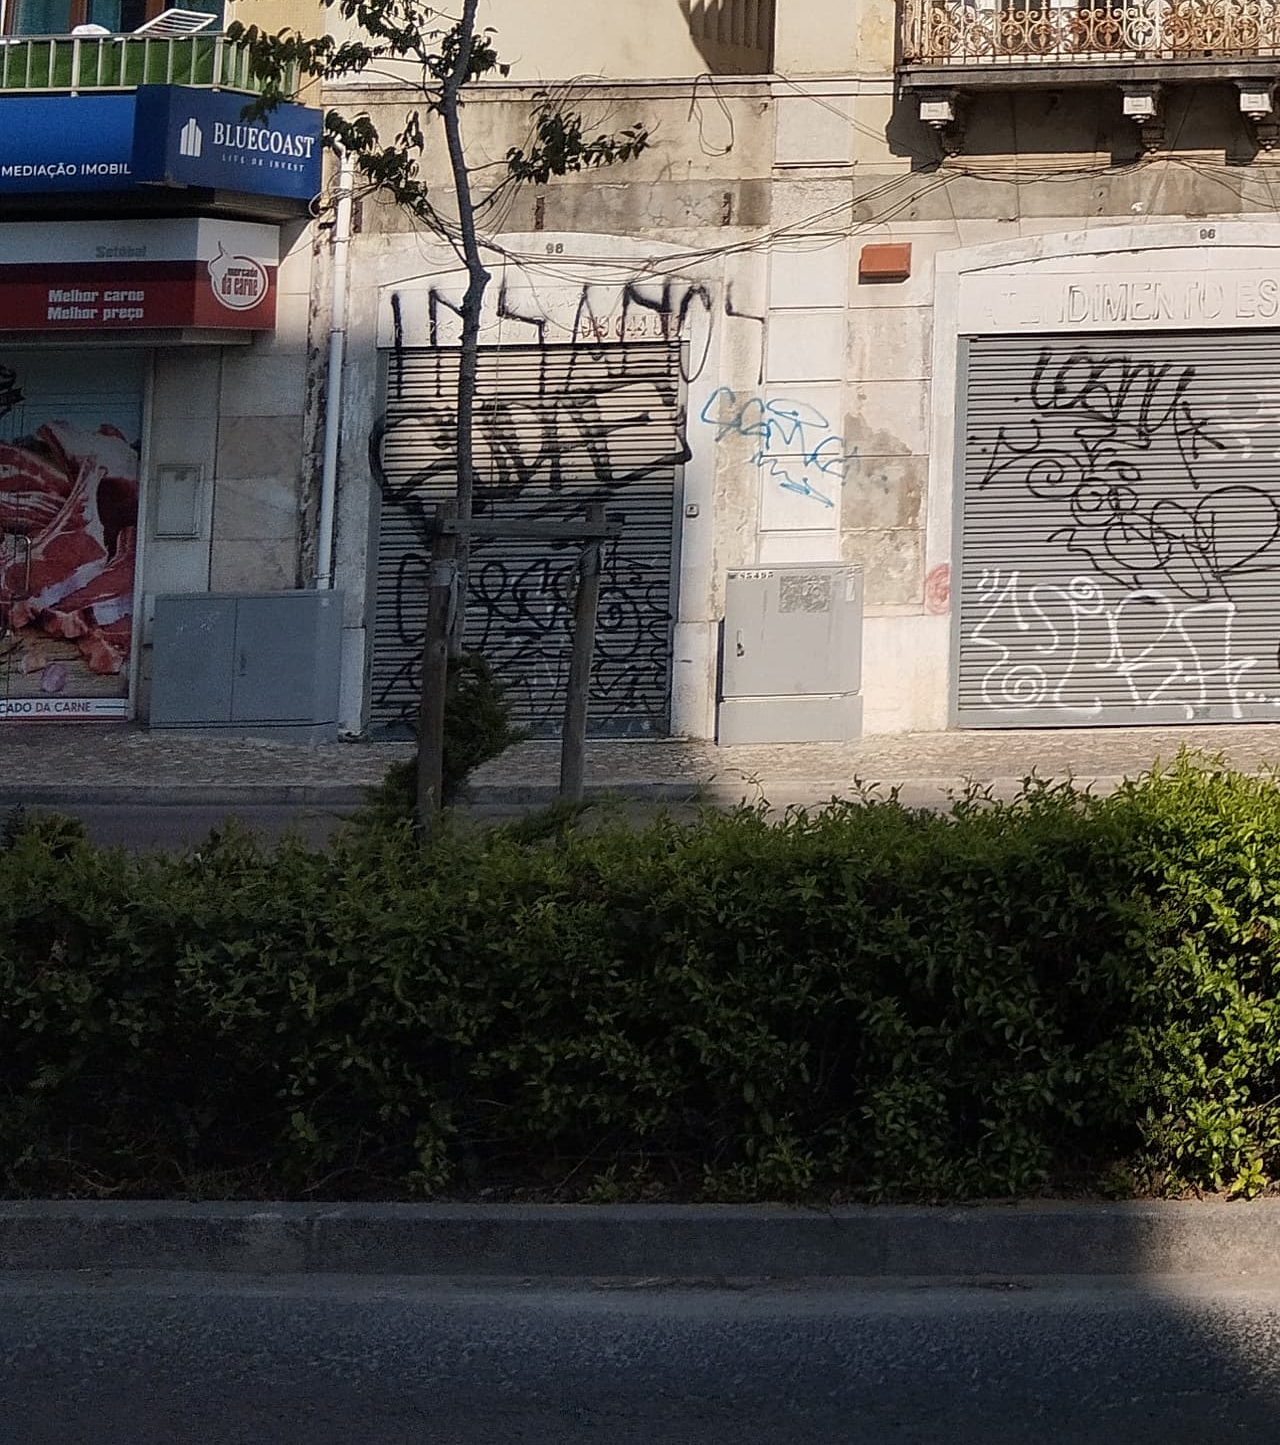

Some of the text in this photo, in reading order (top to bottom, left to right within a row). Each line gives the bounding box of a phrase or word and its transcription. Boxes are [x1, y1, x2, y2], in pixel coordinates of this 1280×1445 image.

[213, 121, 315, 159] BLUECOAST
[1, 162, 132, 178] MEDIAÇÃO IMOBIL
[48, 289, 145, 303] Melhor carne
[47, 306, 144, 322] Melhor preço
[35, 702, 51, 713] DA
[54, 701, 91, 713] CARNE
